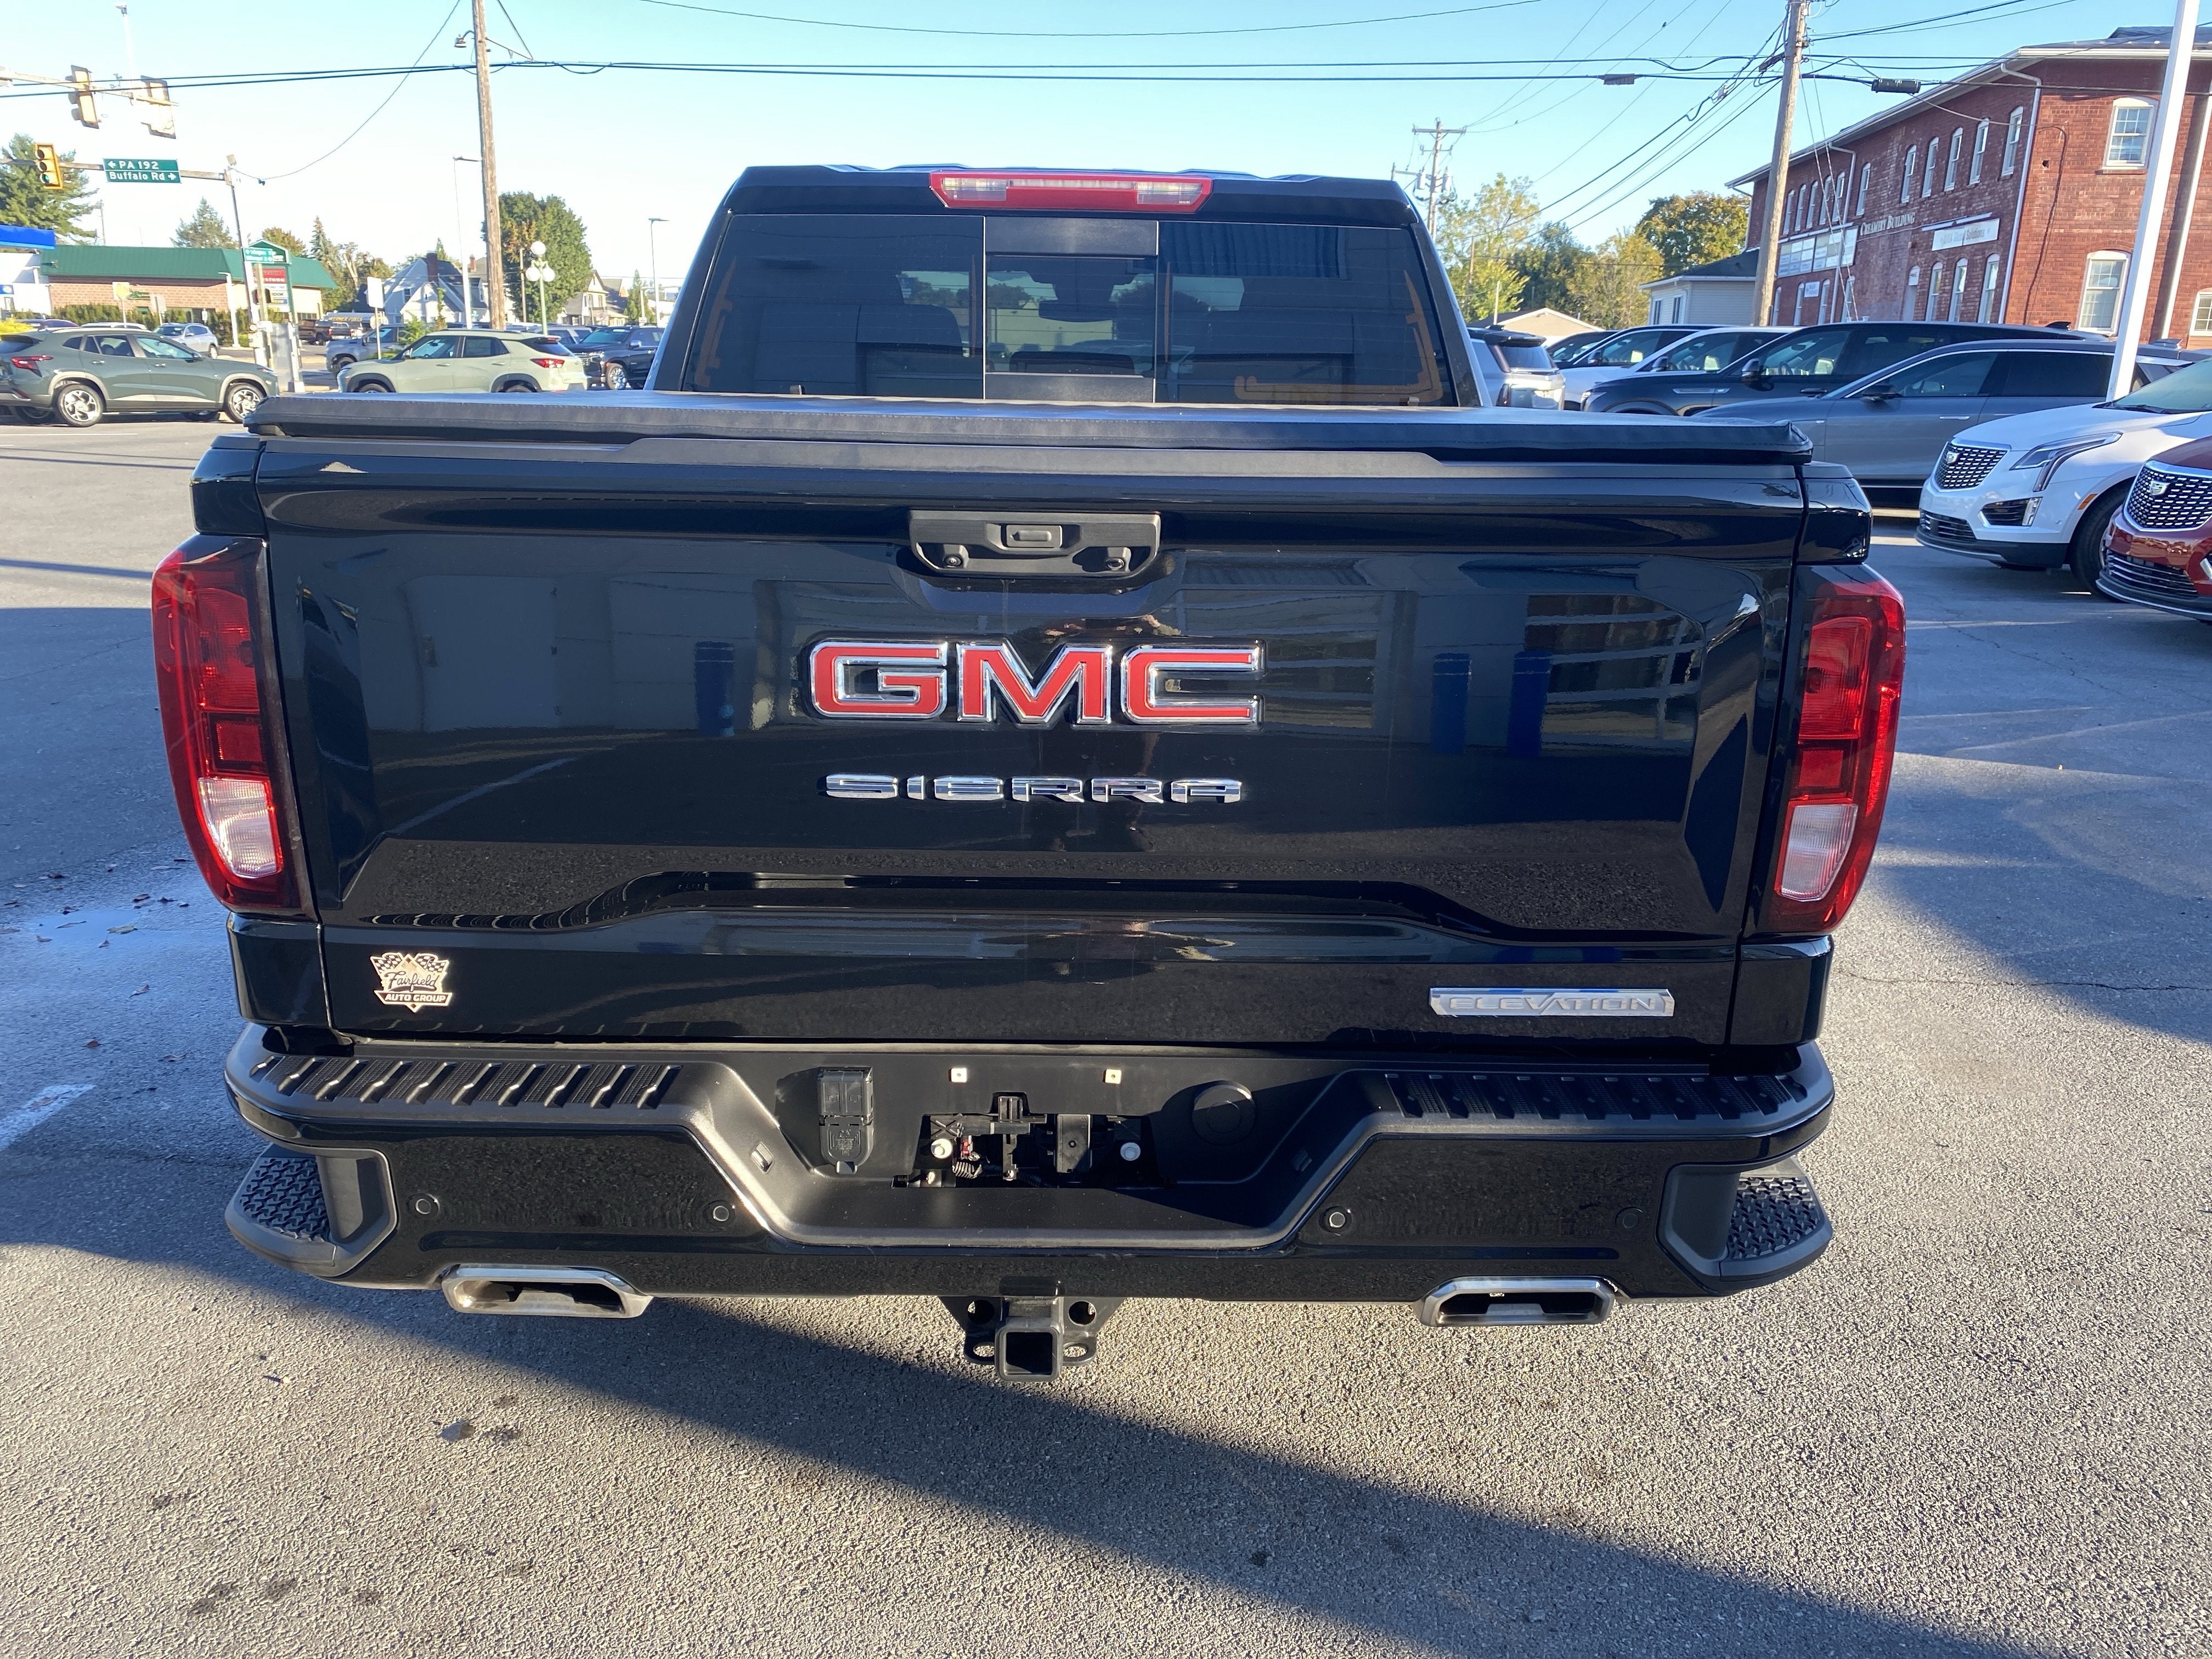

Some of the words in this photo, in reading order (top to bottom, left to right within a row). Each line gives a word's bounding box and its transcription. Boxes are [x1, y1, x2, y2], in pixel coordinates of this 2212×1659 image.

[119, 160, 135, 169] PA
[138, 161, 159, 170] 192
[109, 171, 149, 180] Buffalo
[151, 172, 165, 180] Rd
[809, 640, 1261, 725] GMC
[825, 773, 1243, 804] SIERRA
[384, 970, 440, 991] Fairfield
[413, 994, 445, 1002] GROUP
[1449, 997, 1656, 1011] ELEVATION
